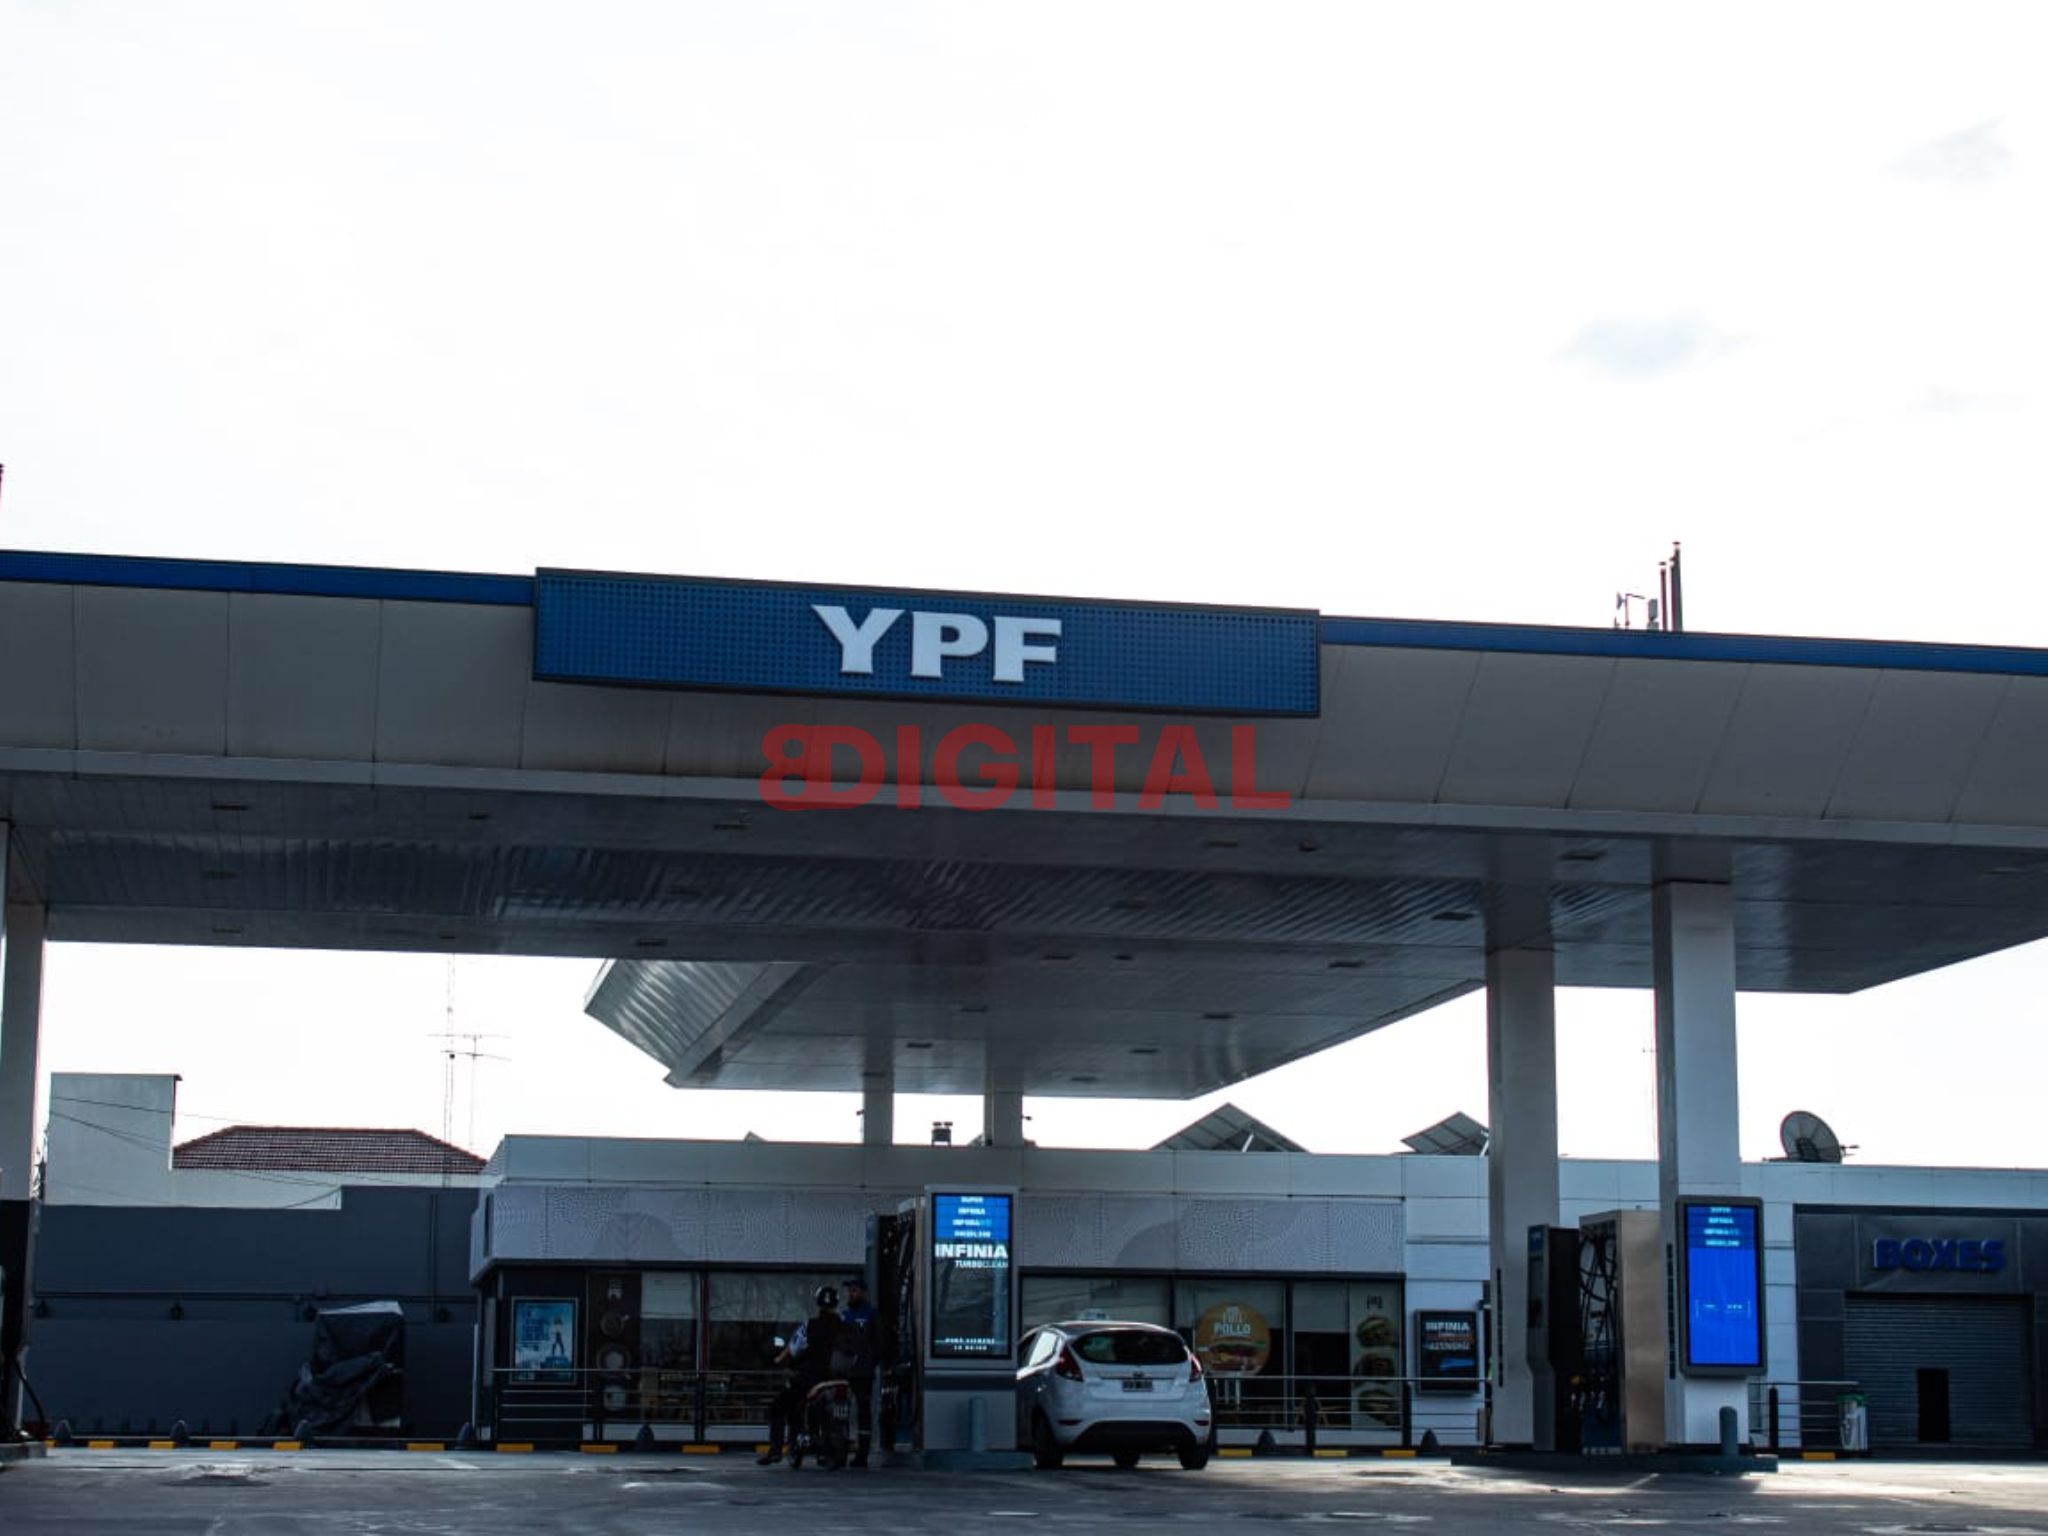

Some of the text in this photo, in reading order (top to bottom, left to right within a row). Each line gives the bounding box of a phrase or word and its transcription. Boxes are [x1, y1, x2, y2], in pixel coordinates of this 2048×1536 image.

[811, 603, 1063, 684] YPF
[935, 1243, 1008, 1259] INFINIA
[1873, 1237, 2006, 1272] BOXES
